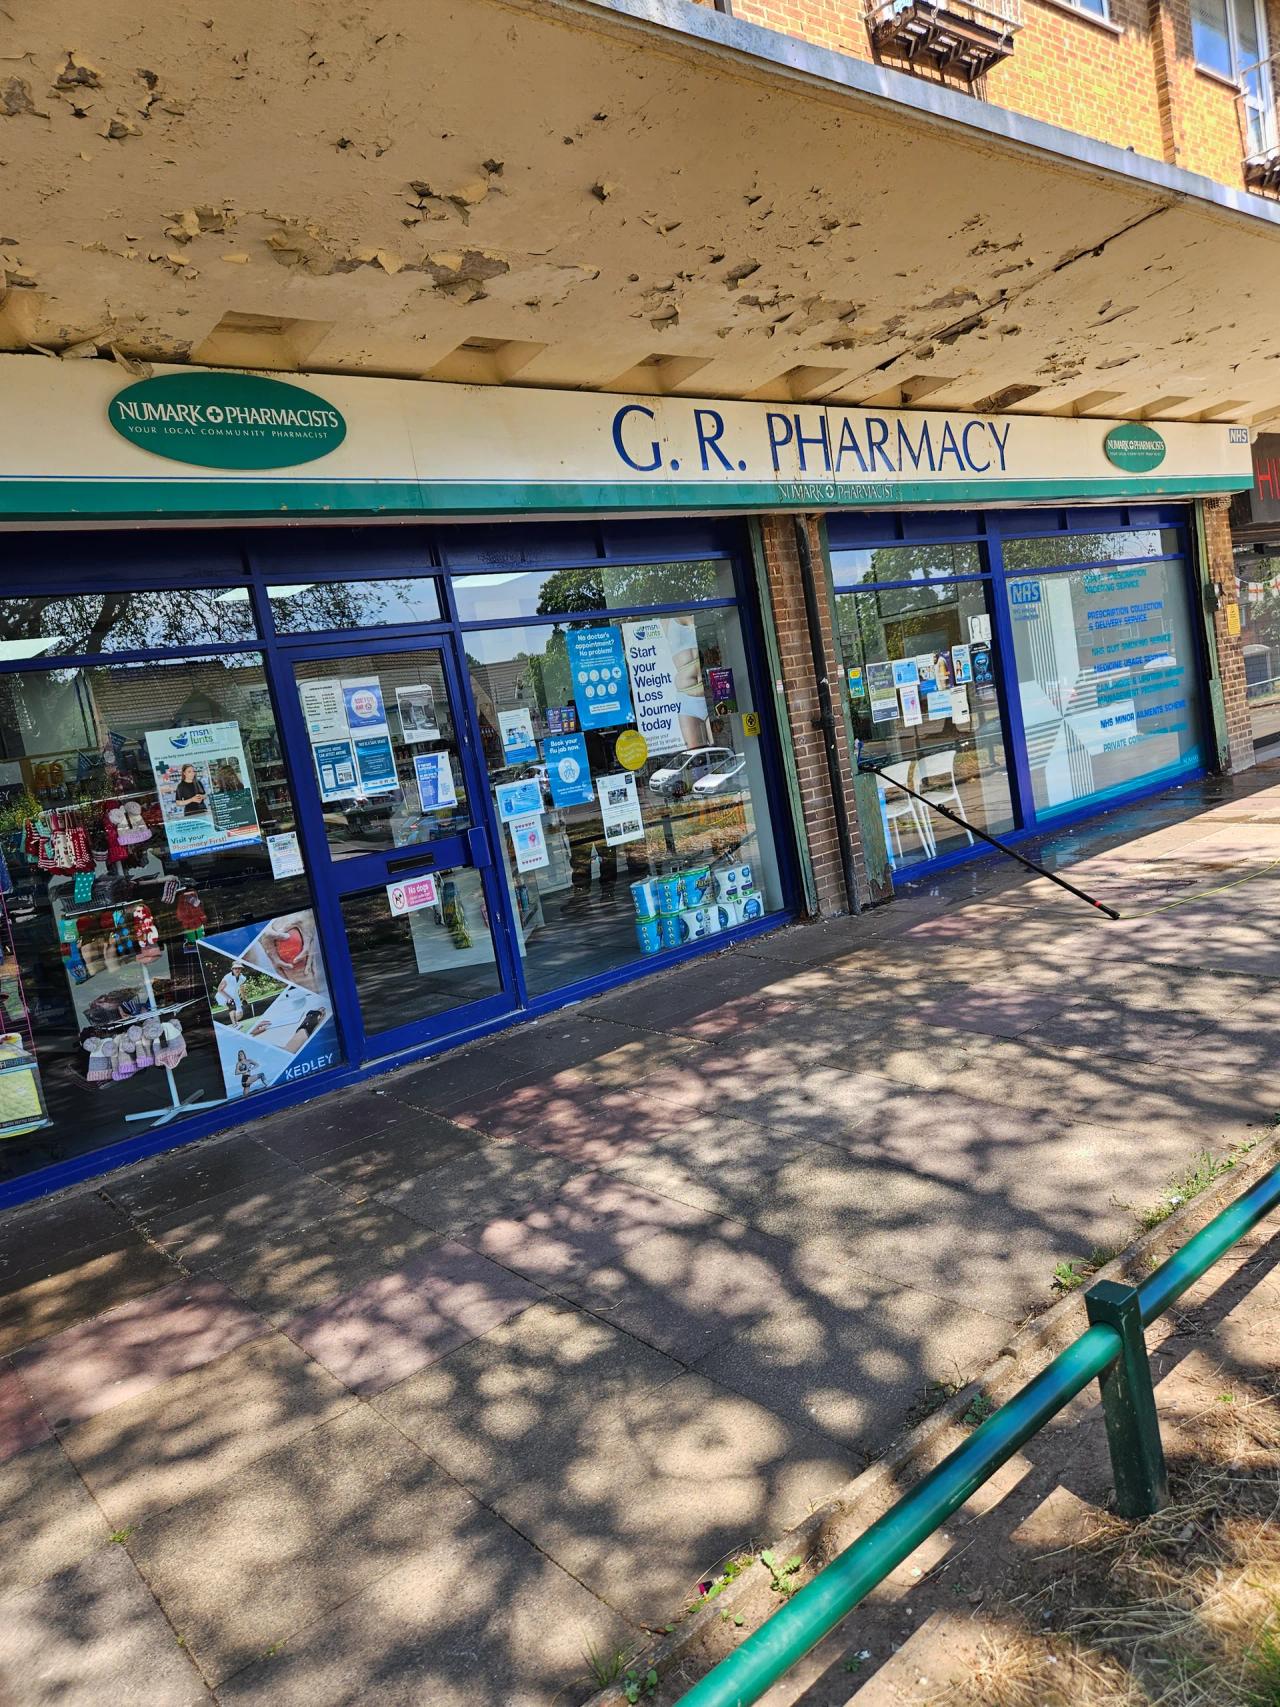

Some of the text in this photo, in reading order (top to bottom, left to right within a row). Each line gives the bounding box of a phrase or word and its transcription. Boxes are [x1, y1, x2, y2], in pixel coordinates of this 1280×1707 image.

[116, 401, 338, 428] NUMARK PHARMACISTS
[128, 425, 328, 439] YOUR LOCAL COMMUNITY PHARMACIST
[612, 404, 1011, 473] G. R. PHARMACY
[1230, 429, 1248, 443] NHS
[1107, 439, 1131, 451] NUMARK
[1011, 582, 1041, 604] NHS
[1087, 601, 1163, 620] PRESCRIPTION COLLECTION
[1095, 618, 1122, 630] DELIVERY
[1124, 614, 1148, 625] SERVICE
[587, 632, 610, 640] doctor's
[575, 639, 615, 651] appointment?
[589, 647, 613, 657] problem!
[630, 645, 657, 659] Start
[632, 662, 656, 676] your
[634, 672, 672, 688] Weight
[637, 690, 664, 703] Loss
[640, 702, 681, 718] Journey
[1100, 717, 1114, 728] NHS
[1115, 712, 1135, 725] MINOR
[1136, 705, 1164, 719] AILMENTS
[641, 718, 672, 732] today
[190, 728, 209, 738] msn
[190, 735, 214, 744] lunts
[1103, 738, 1128, 752] PRIVATE
[171, 834, 205, 845] Visit your
[416, 884, 429, 893] dogs
[285, 1053, 333, 1080] KEDLEY
